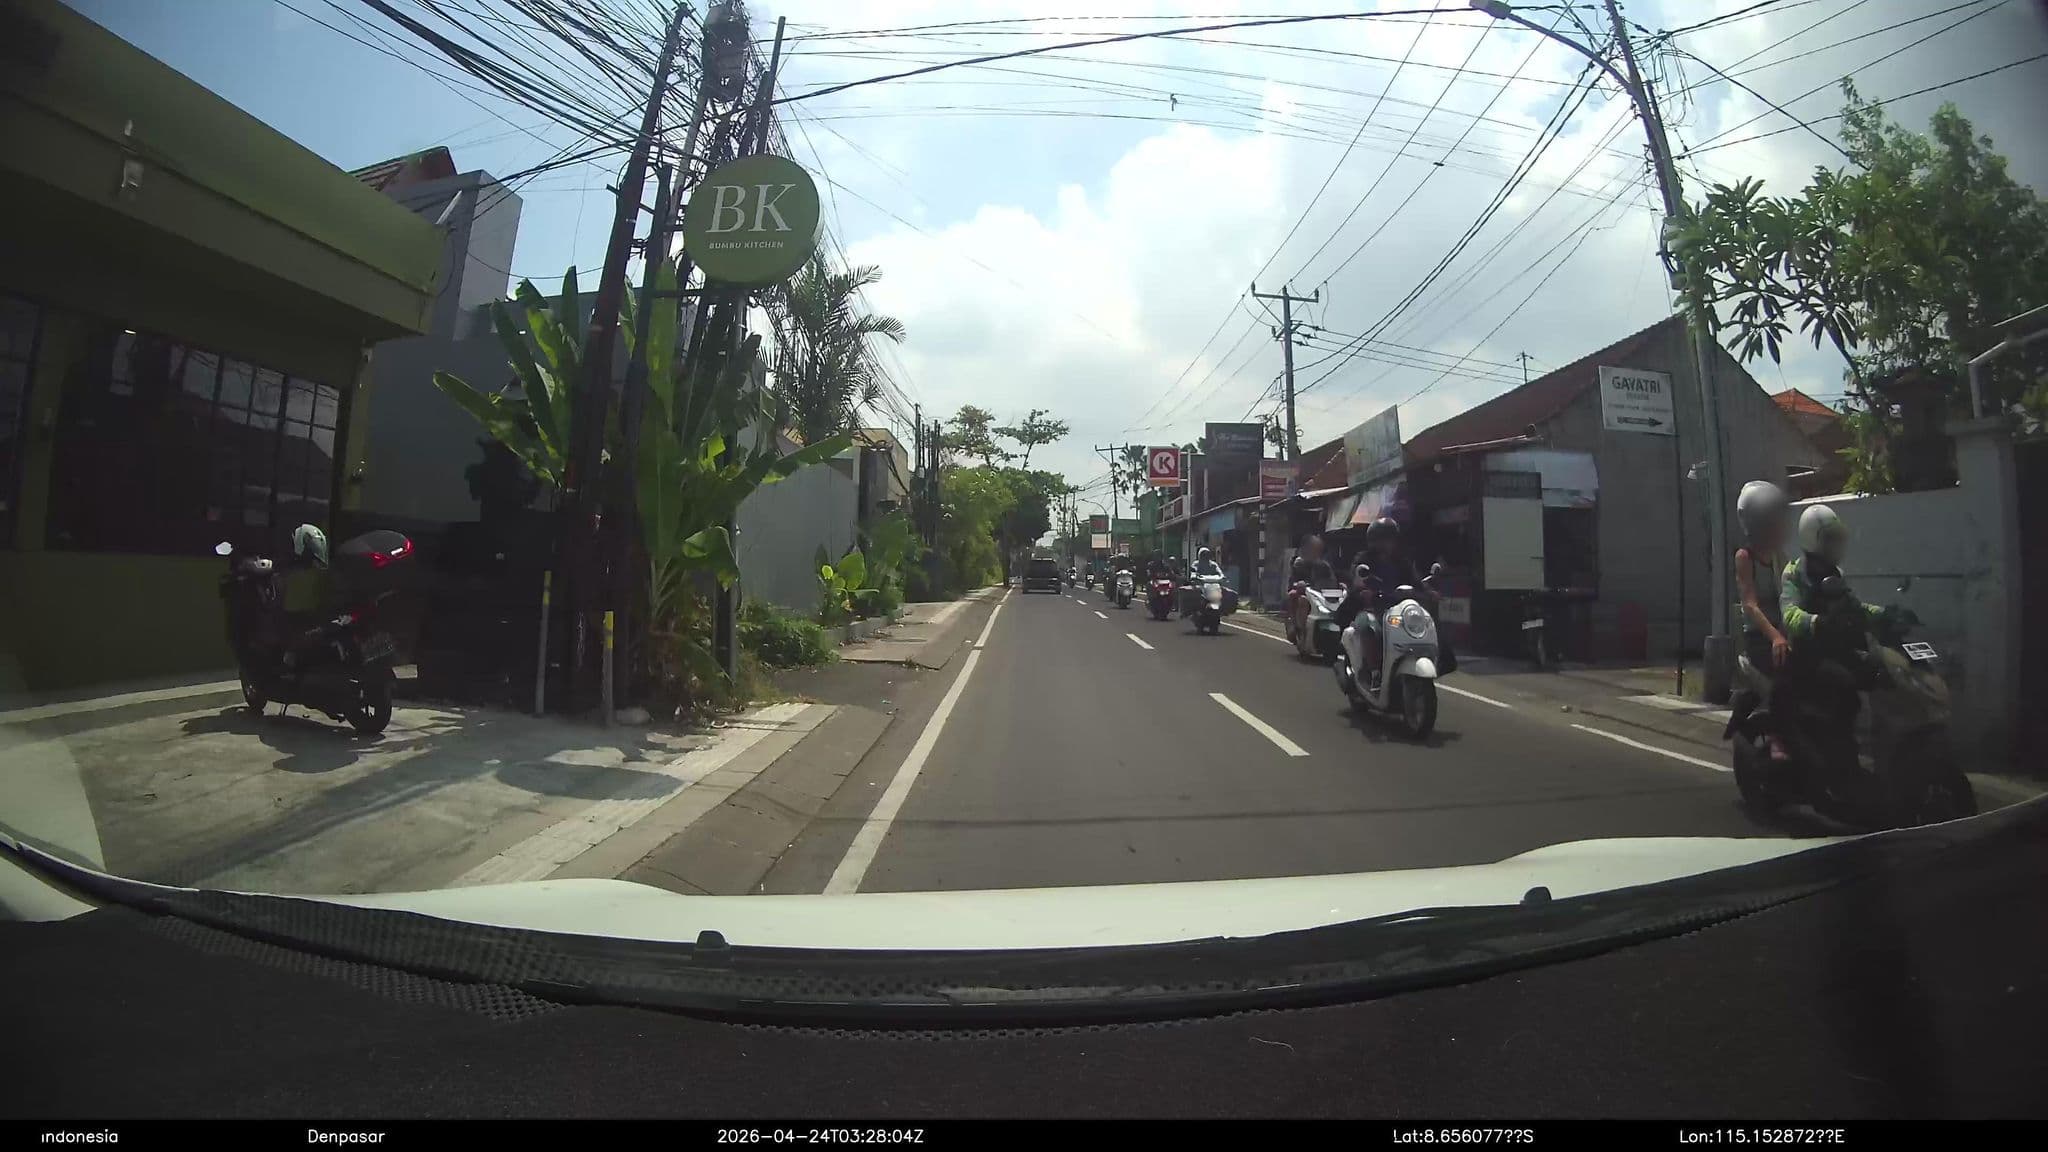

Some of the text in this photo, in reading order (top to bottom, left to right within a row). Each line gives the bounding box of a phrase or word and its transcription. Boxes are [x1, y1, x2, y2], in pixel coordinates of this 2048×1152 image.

[705, 183, 796, 233] BK
[709, 240, 784, 249] BUMBU KITCHEN
[1611, 376, 1661, 393] GAYATRI
